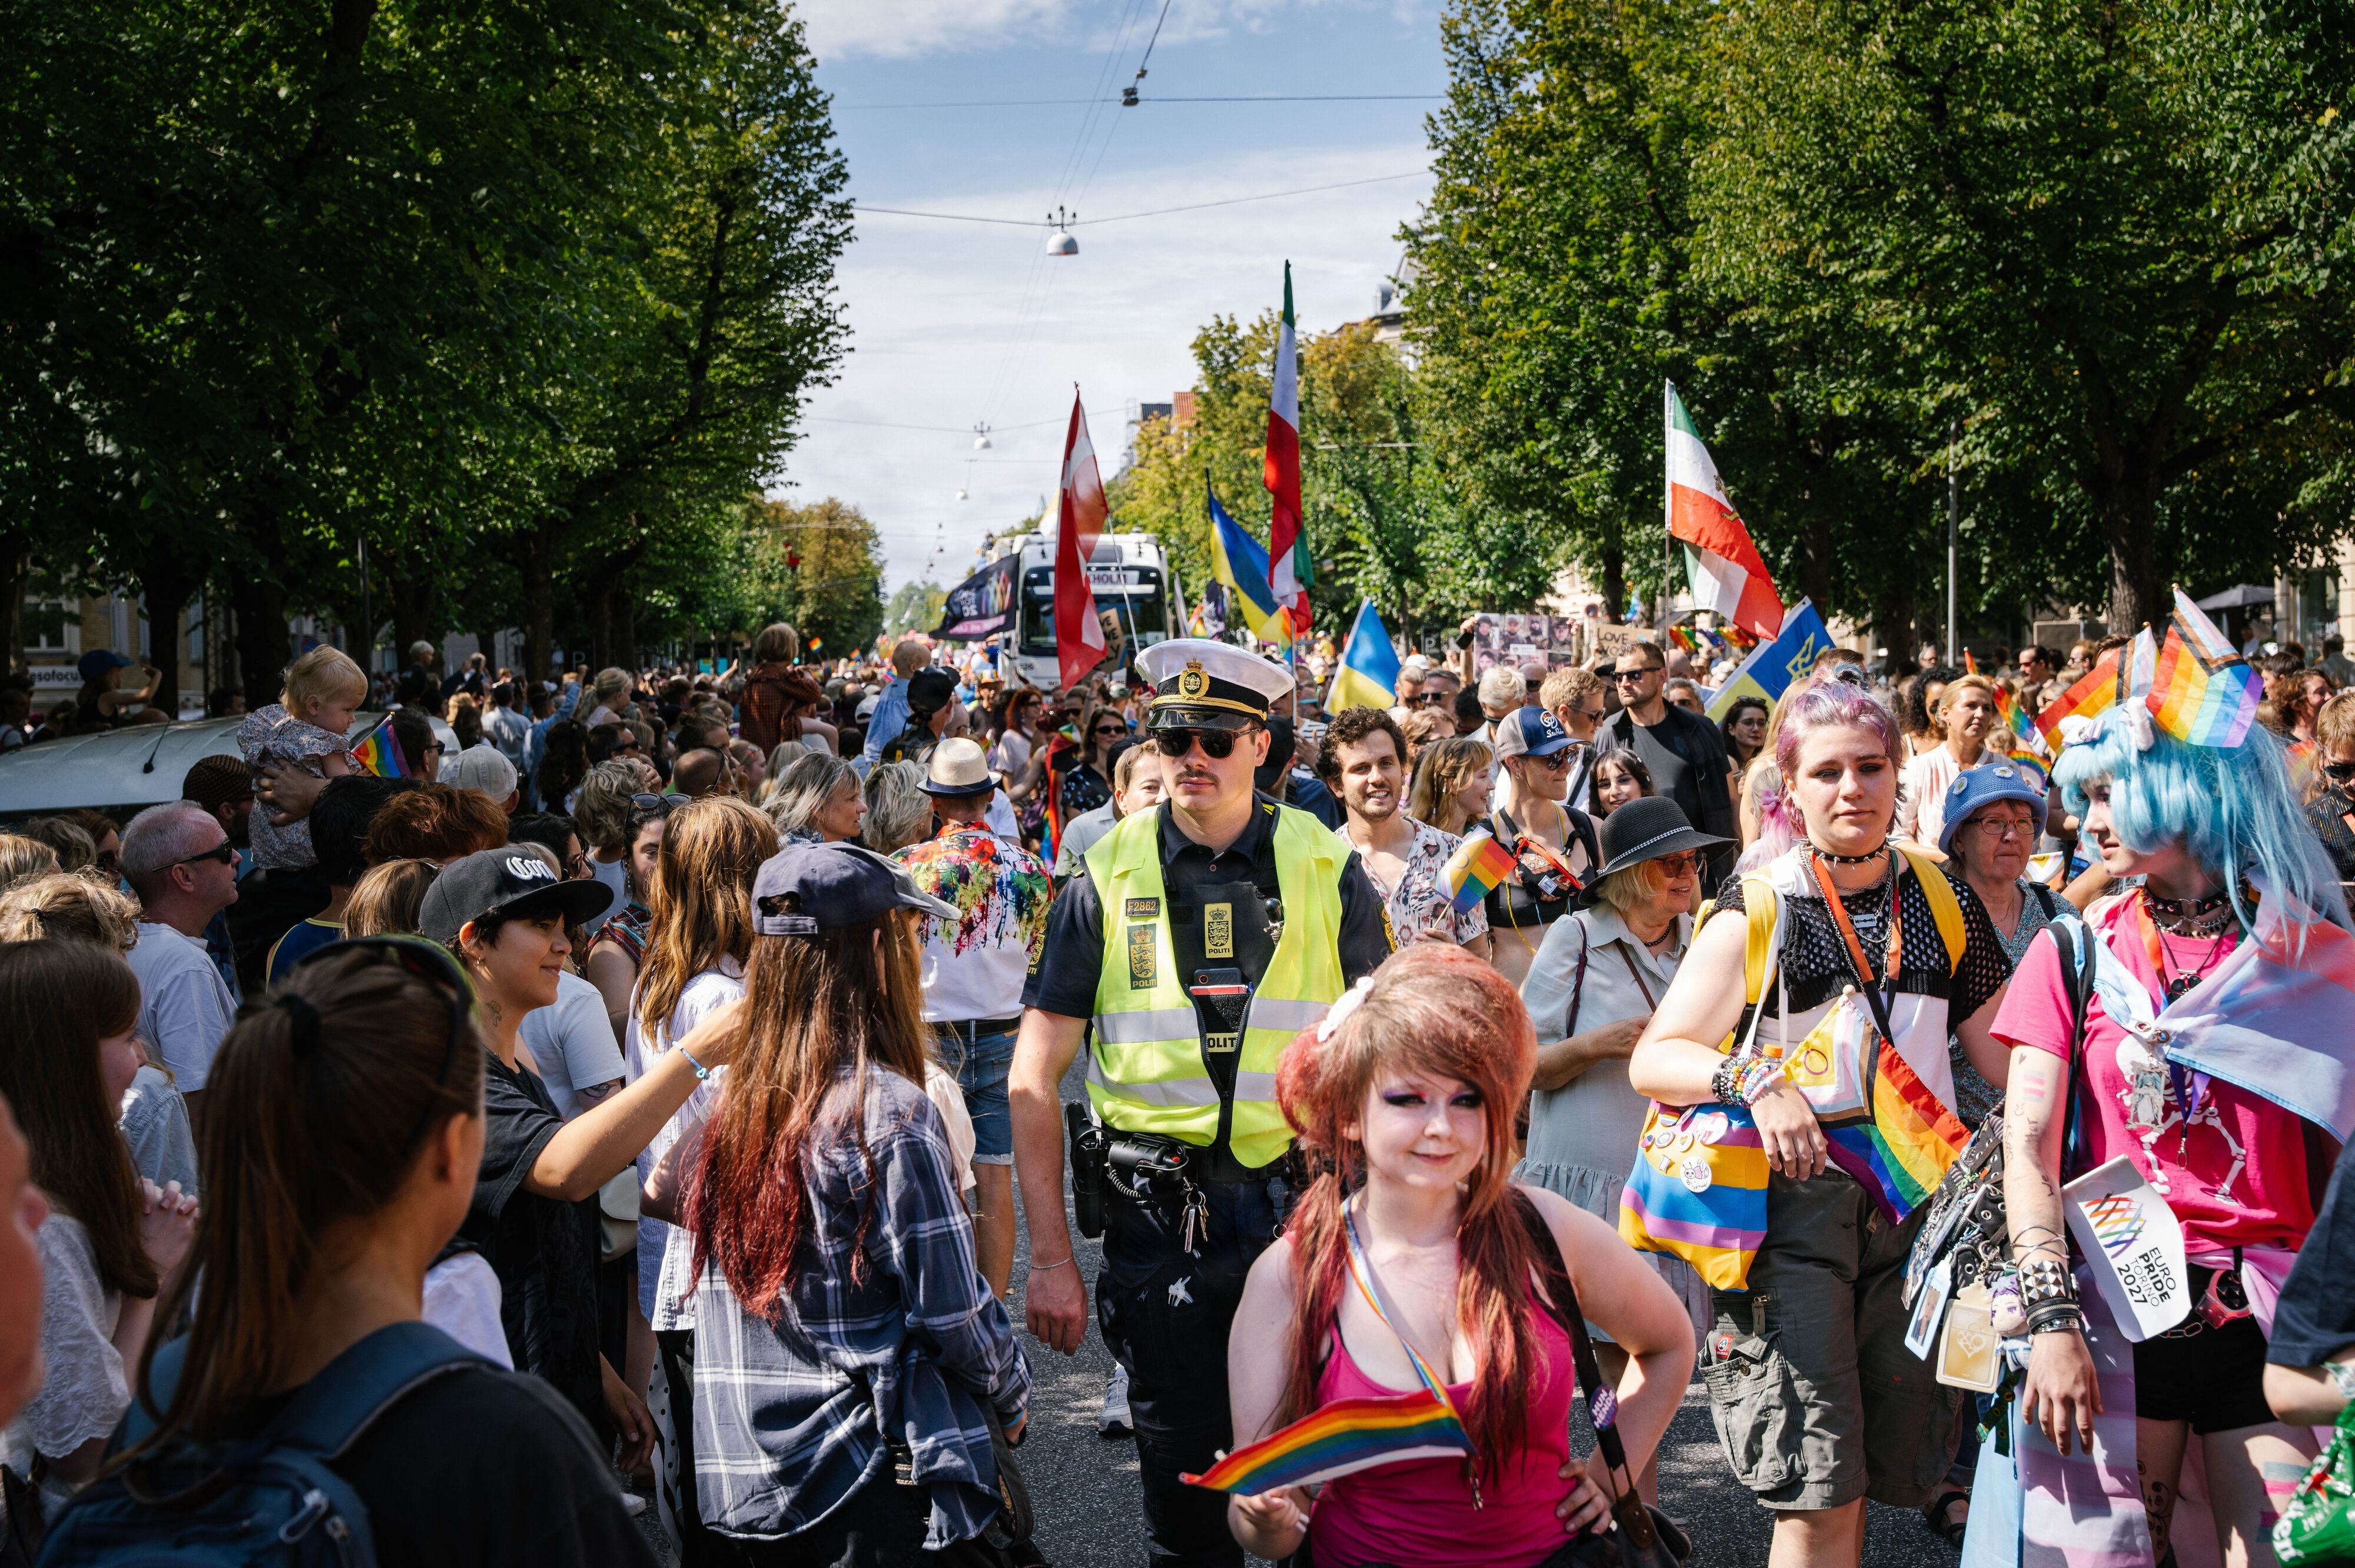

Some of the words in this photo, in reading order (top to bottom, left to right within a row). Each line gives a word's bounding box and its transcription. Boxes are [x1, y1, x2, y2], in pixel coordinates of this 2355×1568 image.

[1090, 574, 1126, 584] HOLM
[1597, 627, 1628, 645] LOVE
[30, 669, 79, 682] esofocu
[1127, 901, 1156, 912] F2862
[1027, 966, 1037, 975] ITI
[1132, 978, 1156, 988] POLITI
[1207, 1037, 1236, 1048] OLIT
[2149, 1247, 2176, 1290] EURO
[2117, 1264, 2148, 1303] 2027
[2130, 1257, 2160, 1307] TORINO
[2138, 1252, 2171, 1303] PRIDE
